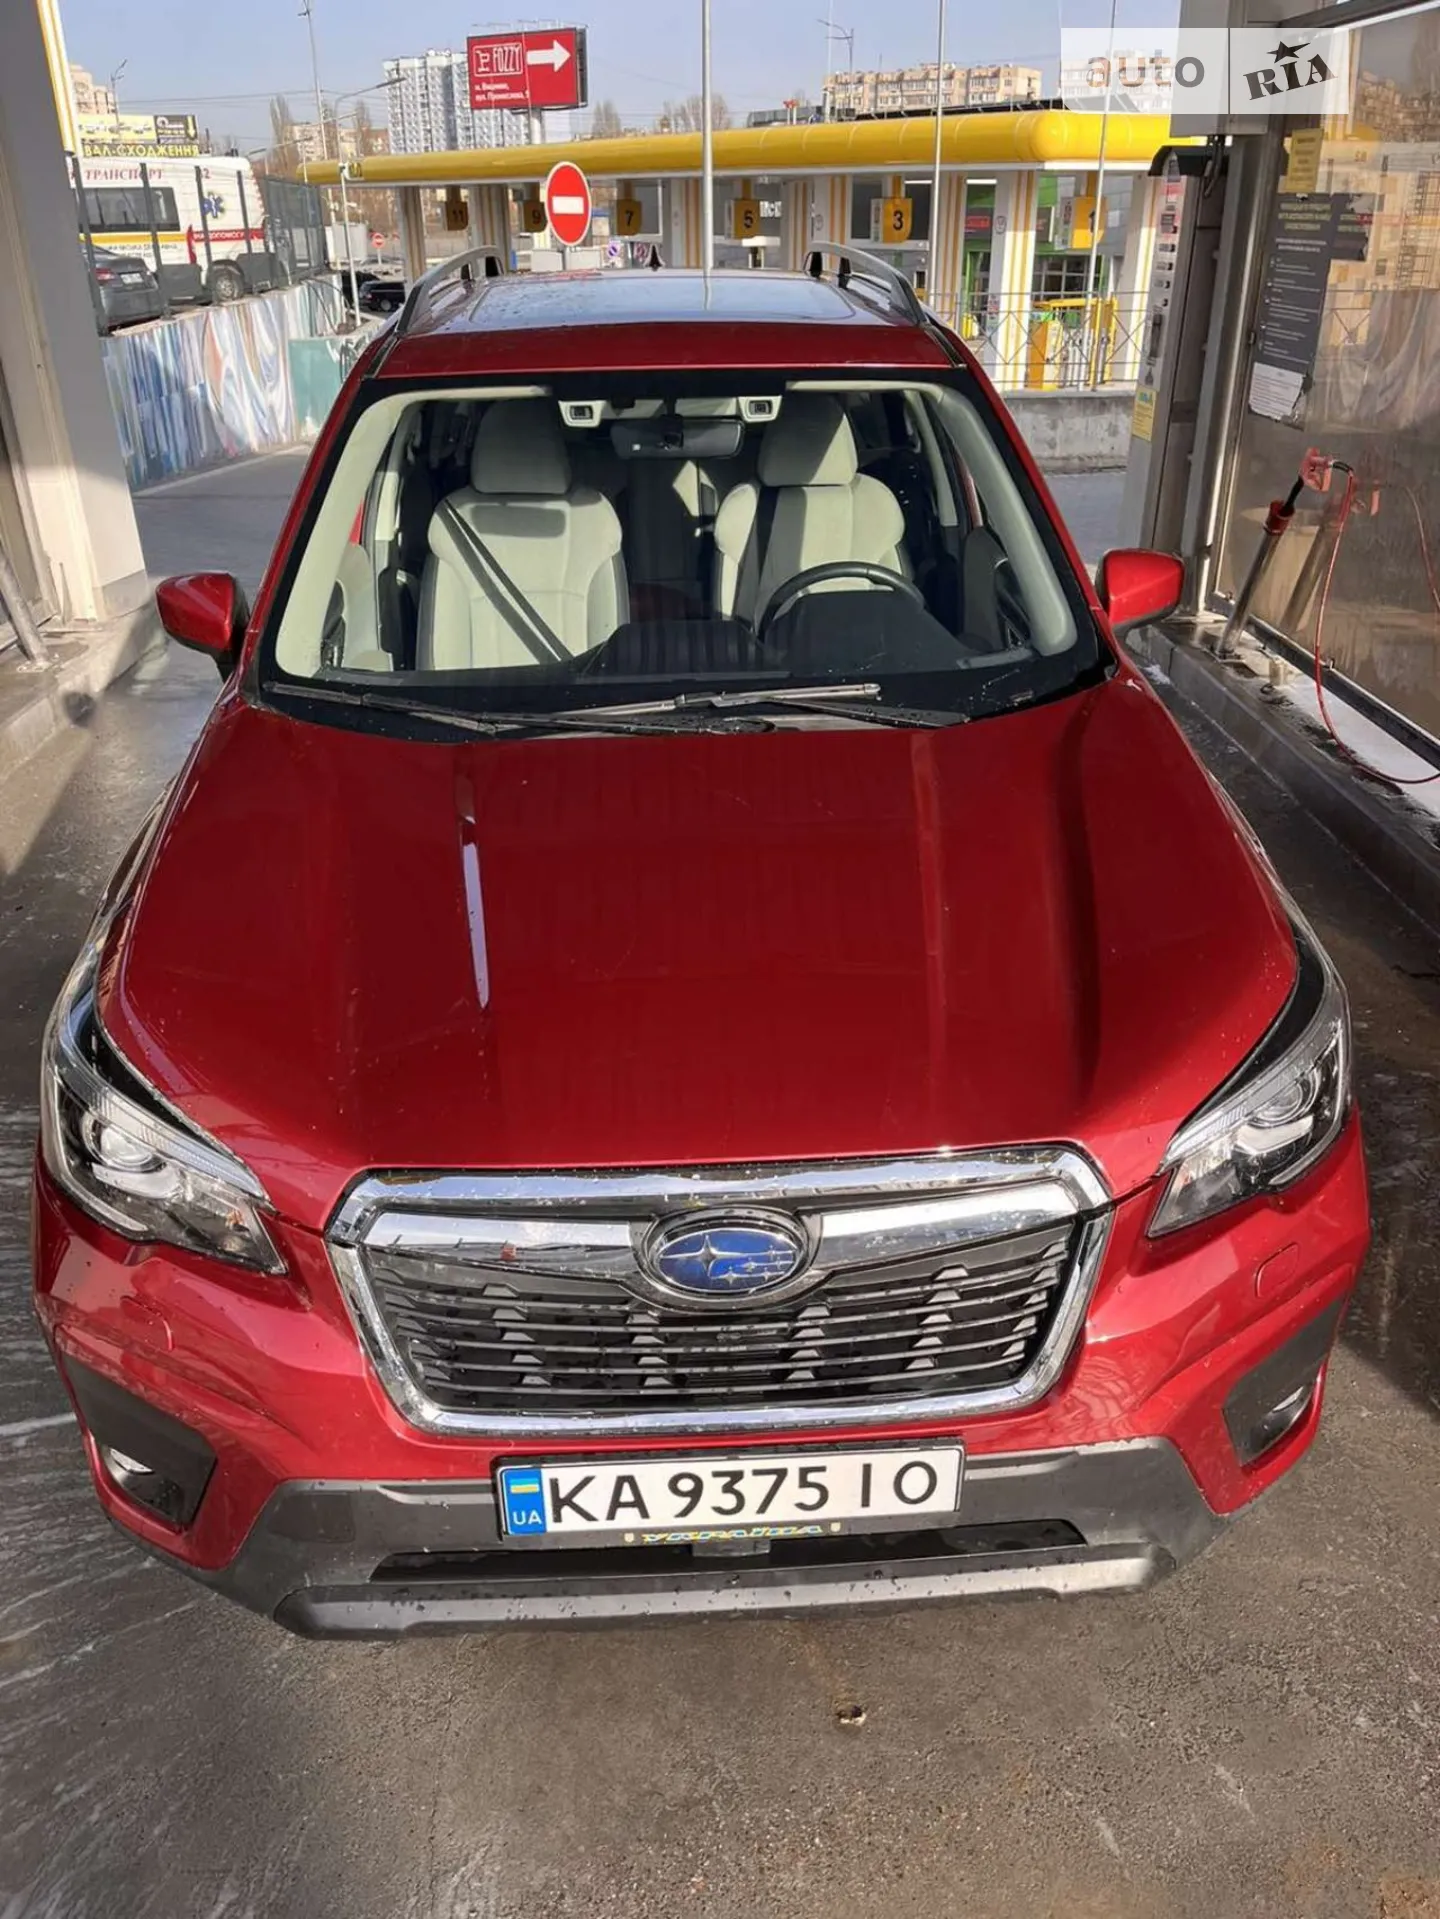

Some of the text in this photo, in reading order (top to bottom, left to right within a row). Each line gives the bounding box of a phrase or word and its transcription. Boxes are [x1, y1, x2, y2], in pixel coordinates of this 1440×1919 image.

[492, 45, 521, 72] FOZZY
[85, 168, 164, 180] ТРАНСПРТ
[532, 210, 542, 222] 9
[625, 210, 634, 226] 7
[744, 210, 753, 228] 5
[892, 210, 904, 231] 3
[549, 1474, 651, 1523] KA
[667, 1465, 829, 1519] 9375
[512, 1510, 542, 1526] UA
